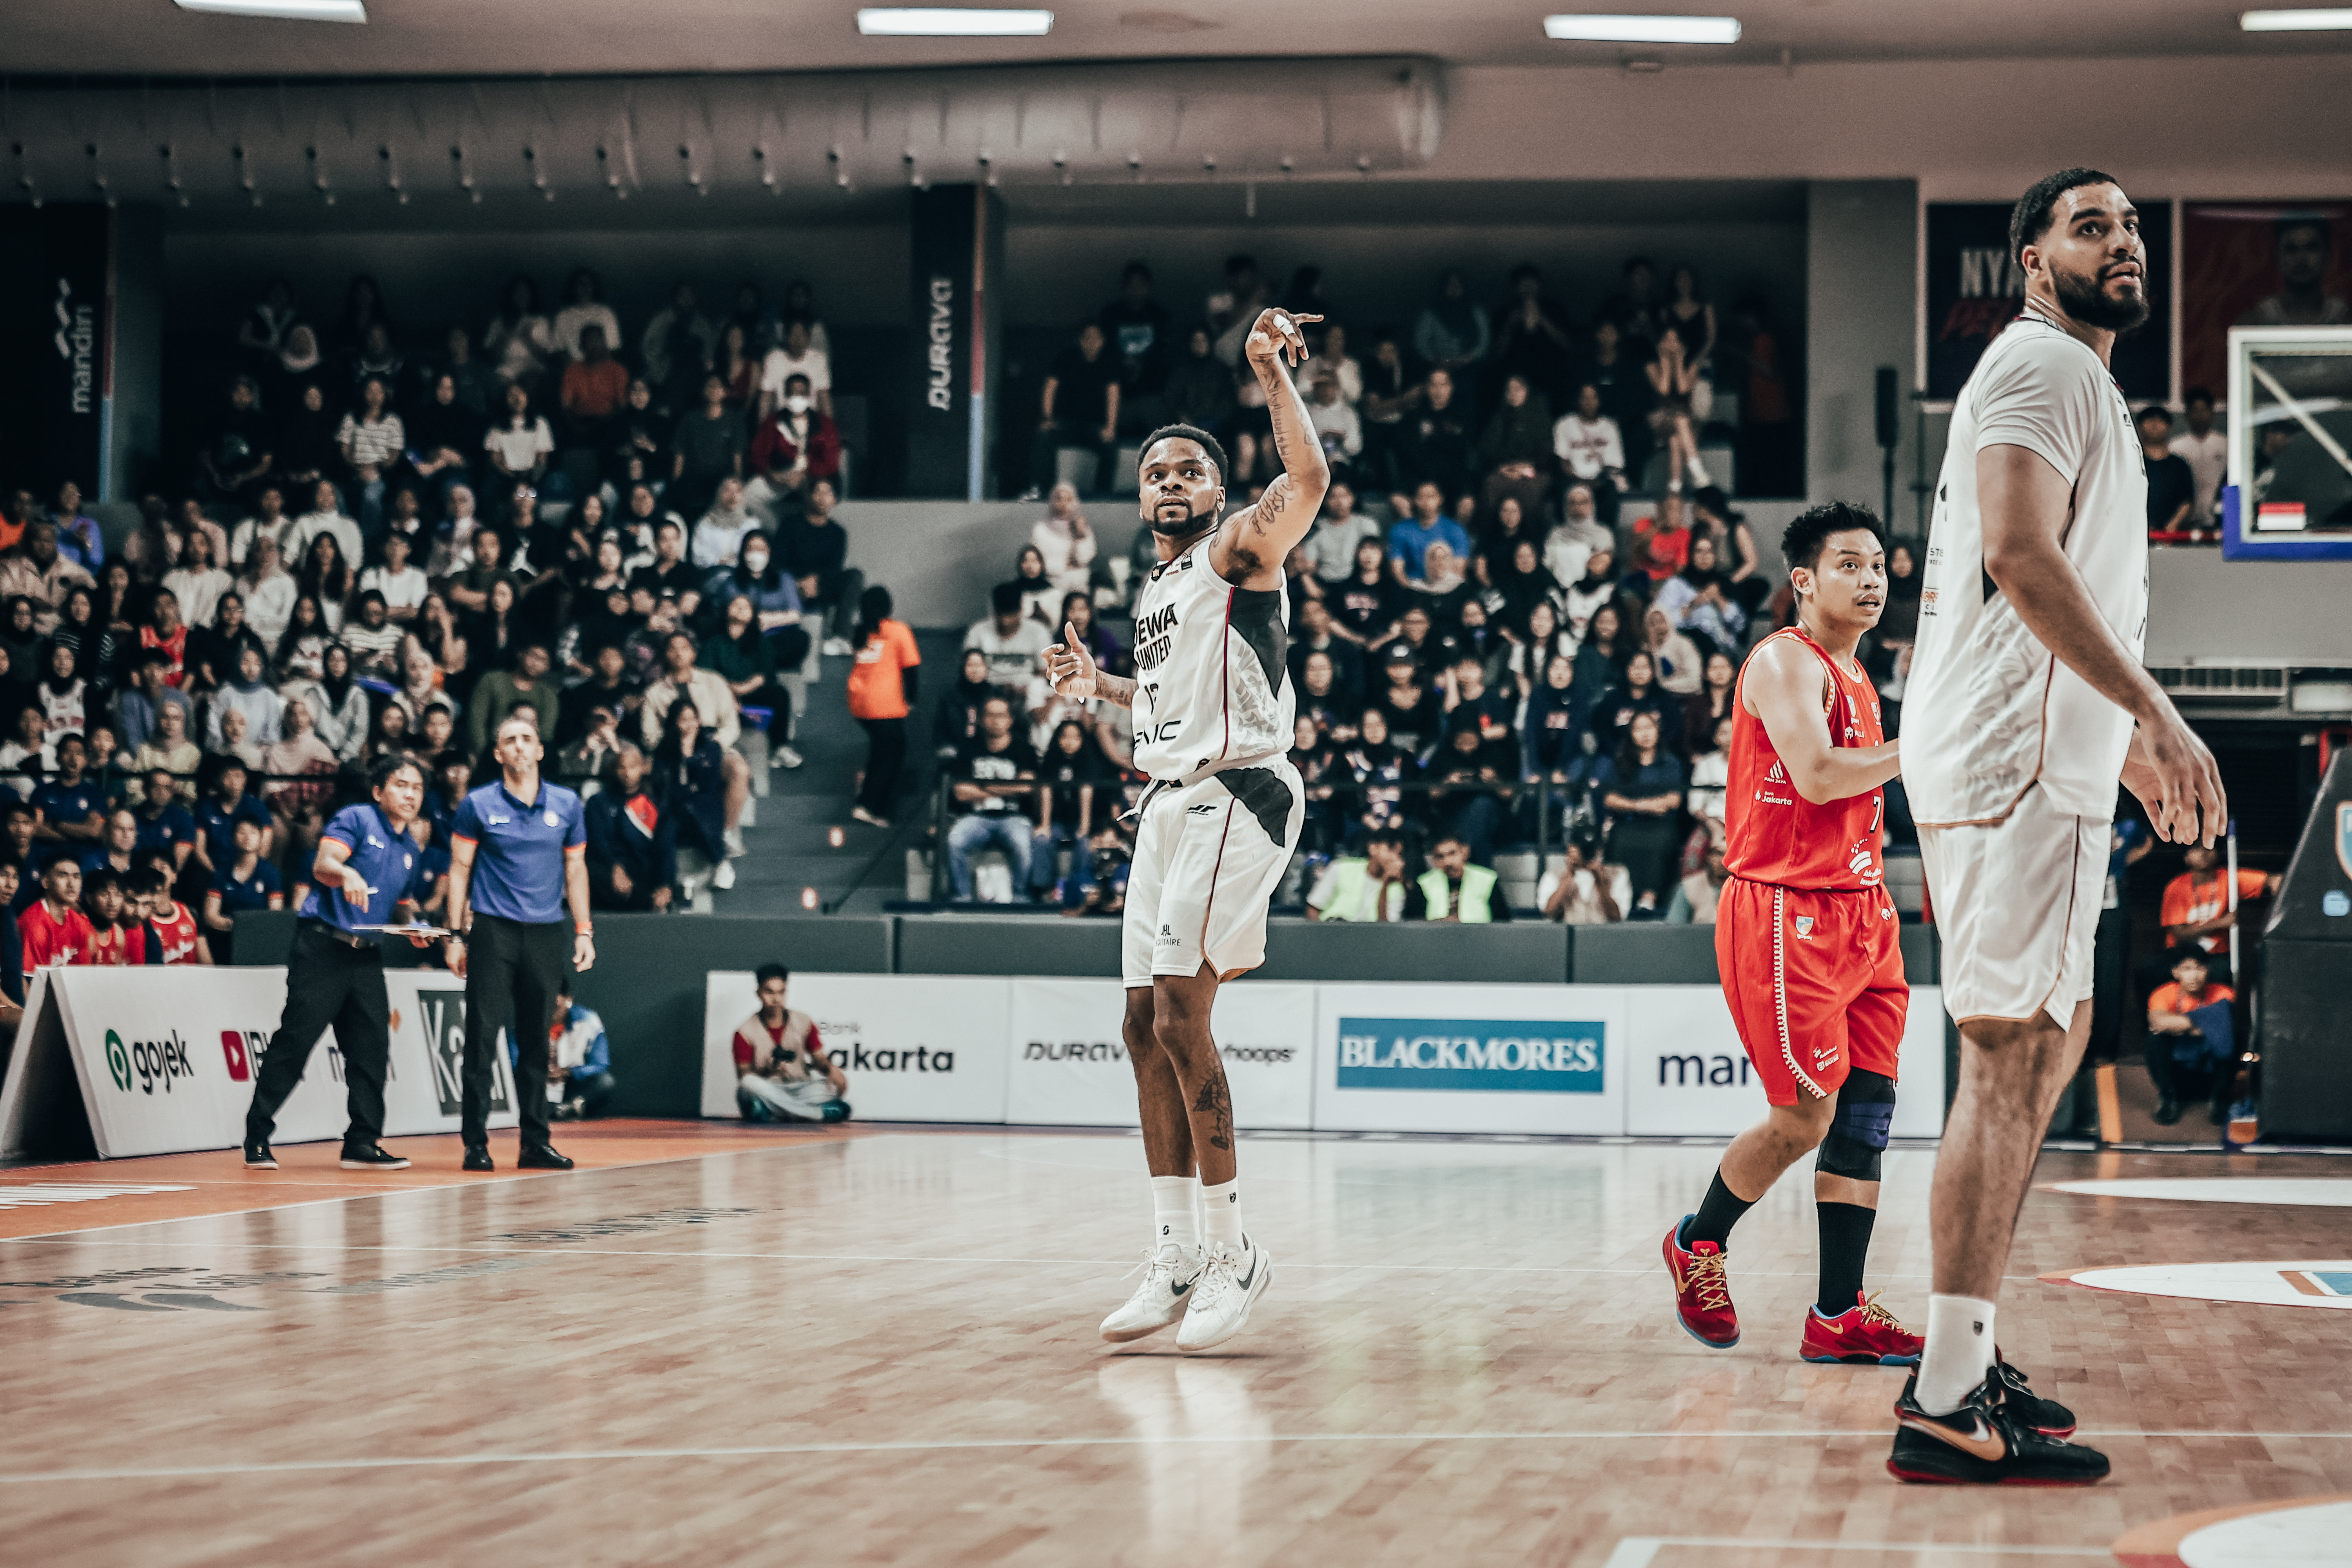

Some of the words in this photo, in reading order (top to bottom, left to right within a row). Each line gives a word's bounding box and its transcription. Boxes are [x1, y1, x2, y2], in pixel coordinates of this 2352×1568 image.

[1138, 602, 1179, 646] EWA
[1136, 634, 1171, 671] UNITED
[1761, 795, 1792, 806] Jakarta
[1869, 795, 1882, 833] 7
[1161, 924, 1171, 936] JHL
[134, 1029, 194, 1095] gojek
[826, 1043, 955, 1073] akarta
[1024, 1042, 1133, 1062] DURAV
[1341, 1036, 1597, 1073] BLACKMORES
